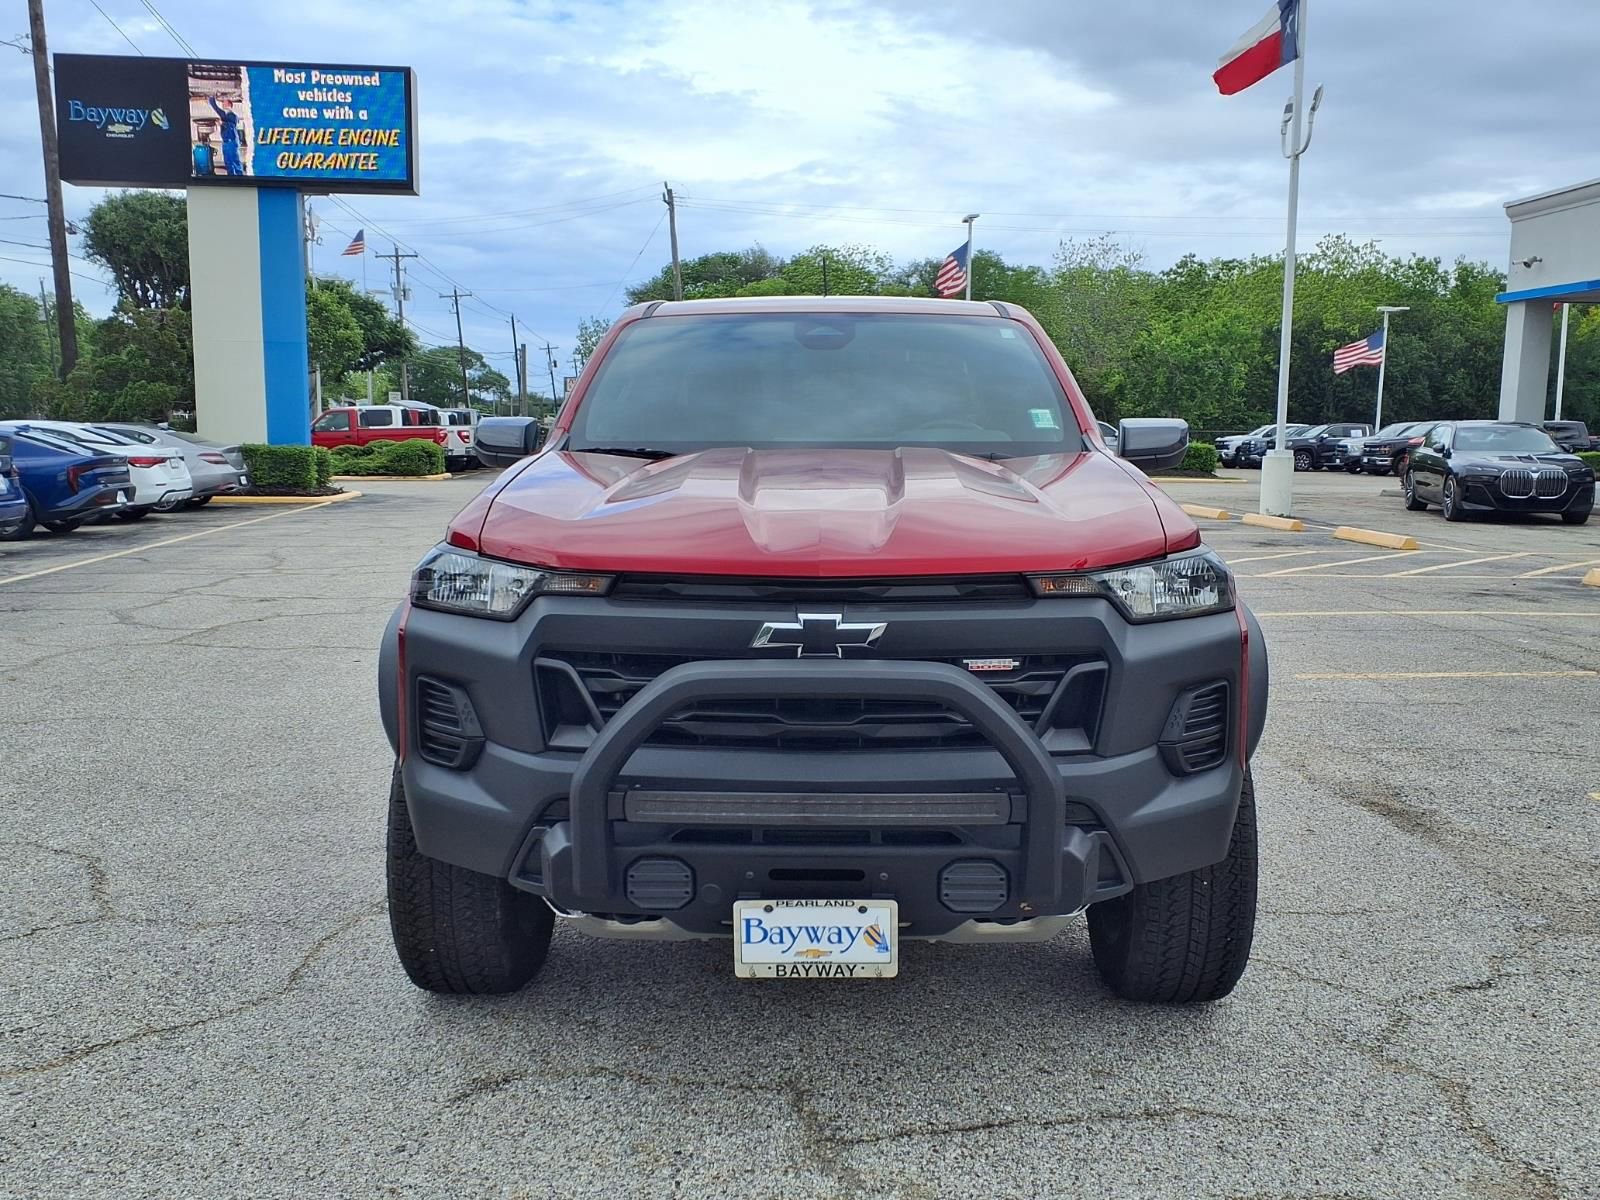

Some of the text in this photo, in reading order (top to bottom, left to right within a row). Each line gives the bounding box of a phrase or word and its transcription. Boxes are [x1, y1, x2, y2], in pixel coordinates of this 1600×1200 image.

[273, 69, 380, 86] Most Preowned
[298, 88, 352, 102] vehicles
[68, 100, 149, 131] Bayway
[282, 106, 368, 120] come with a
[257, 127, 400, 147] LIFETIME ENGINE
[276, 152, 379, 170] GUARANTEE
[775, 900, 855, 908] PEARLAND
[742, 917, 863, 954] Bayway
[775, 964, 857, 977] BAYWAY
